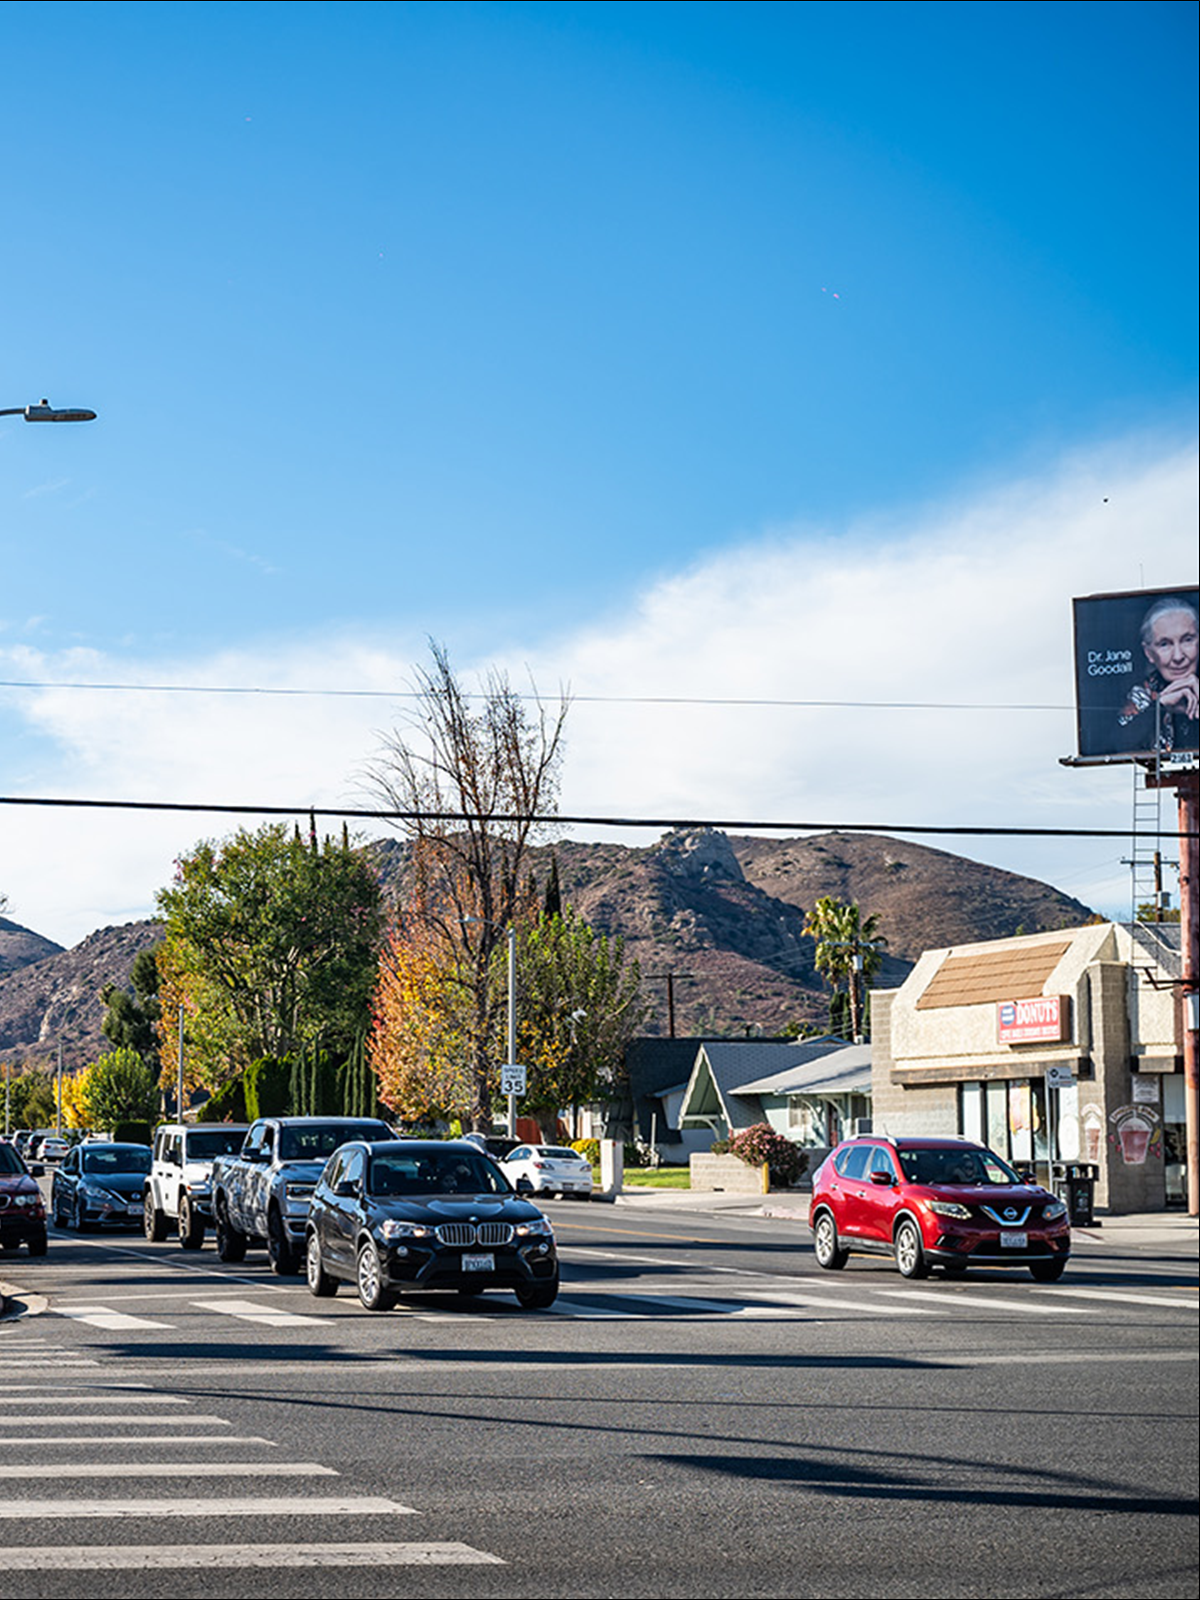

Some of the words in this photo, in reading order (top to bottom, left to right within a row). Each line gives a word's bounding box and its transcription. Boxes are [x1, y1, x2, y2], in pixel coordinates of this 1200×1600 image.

[1087, 651, 1103, 662] Dr.
[1105, 650, 1131, 661] Jane
[1087, 662, 1133, 676] Goodall
[1016, 1000, 1058, 1025] DONUTS
[504, 1080, 523, 1093] 35
